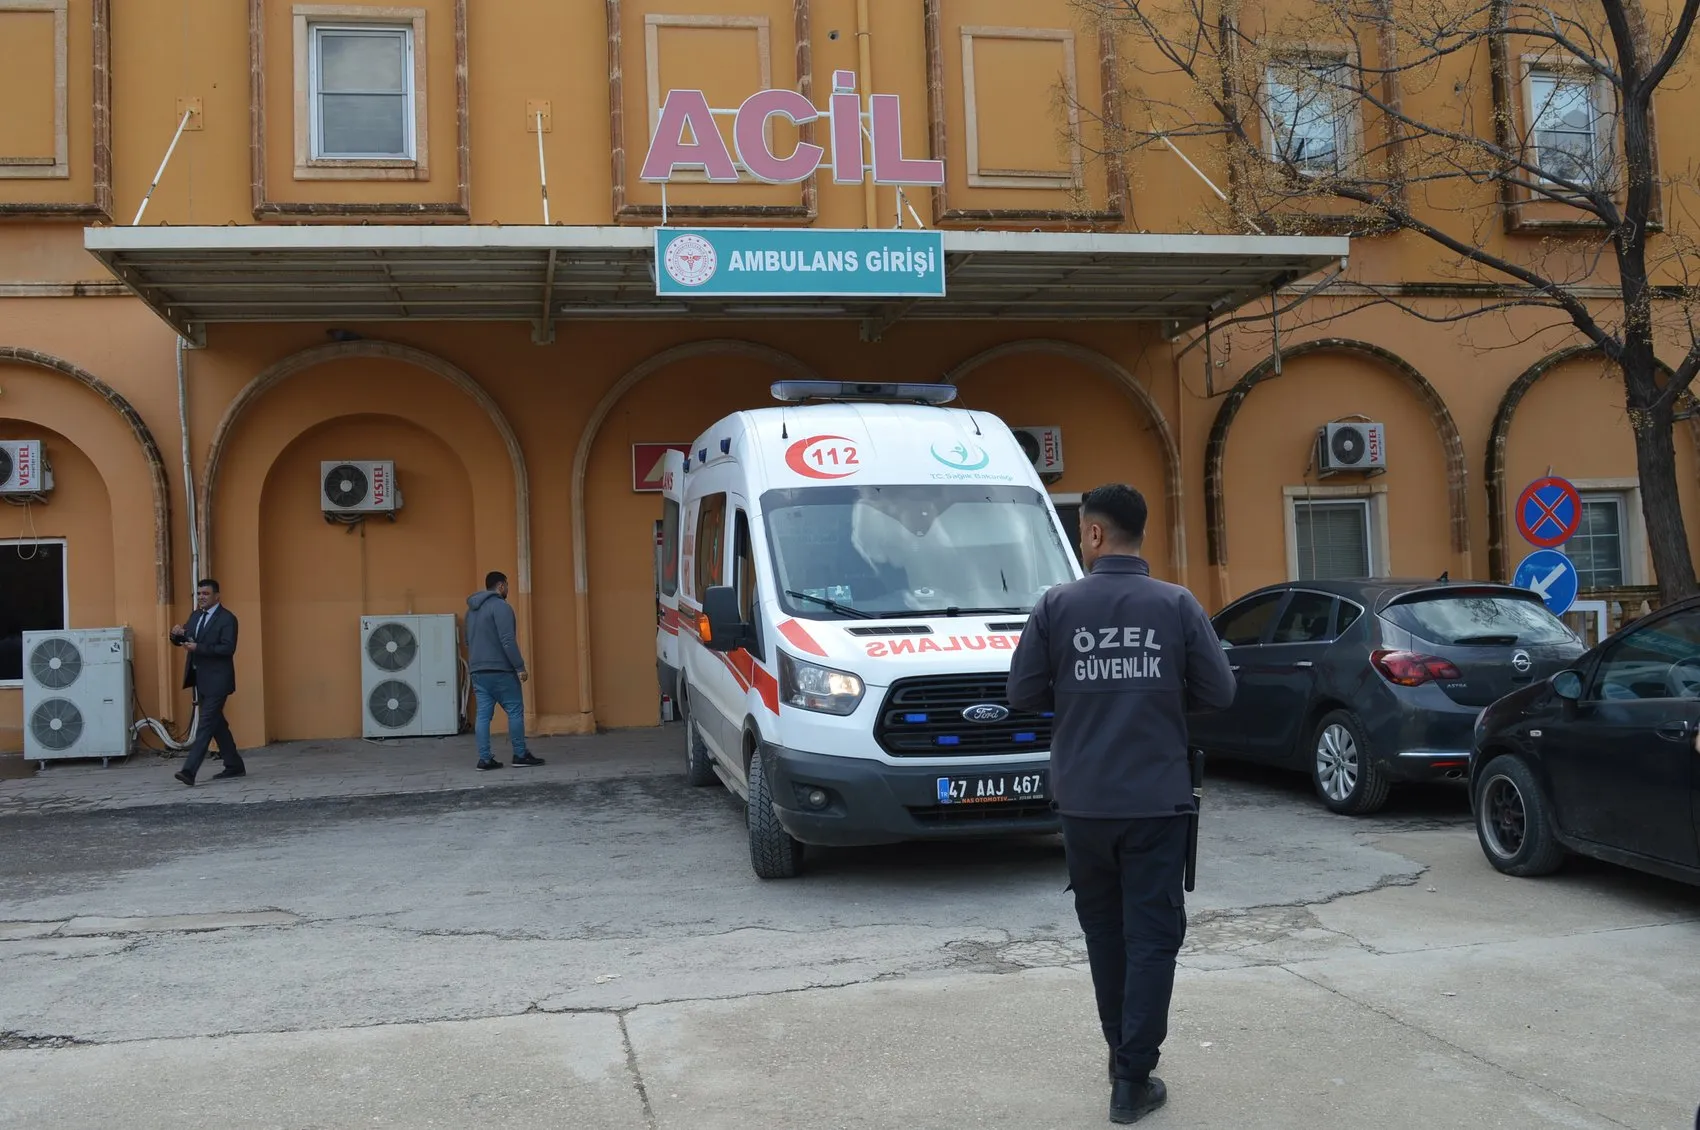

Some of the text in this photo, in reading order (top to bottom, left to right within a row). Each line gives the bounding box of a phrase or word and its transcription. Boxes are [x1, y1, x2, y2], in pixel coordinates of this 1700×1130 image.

[640, 70, 945, 184] ACİL
[728, 250, 859, 272] AMBULANS
[865, 246, 935, 277] GİRİŞİ
[812, 446, 859, 466] 112
[1044, 431, 1054, 467] VESTEL
[1369, 427, 1378, 463] VESTEL
[18, 444, 30, 487] VESTEL
[373, 465, 384, 505] VESTEL
[1073, 626, 1161, 653] ÖZEL
[1074, 651, 1161, 680] GÜVENLİK
[973, 706, 999, 721] Ford
[949, 775, 1040, 798] 47 AAJ 467
